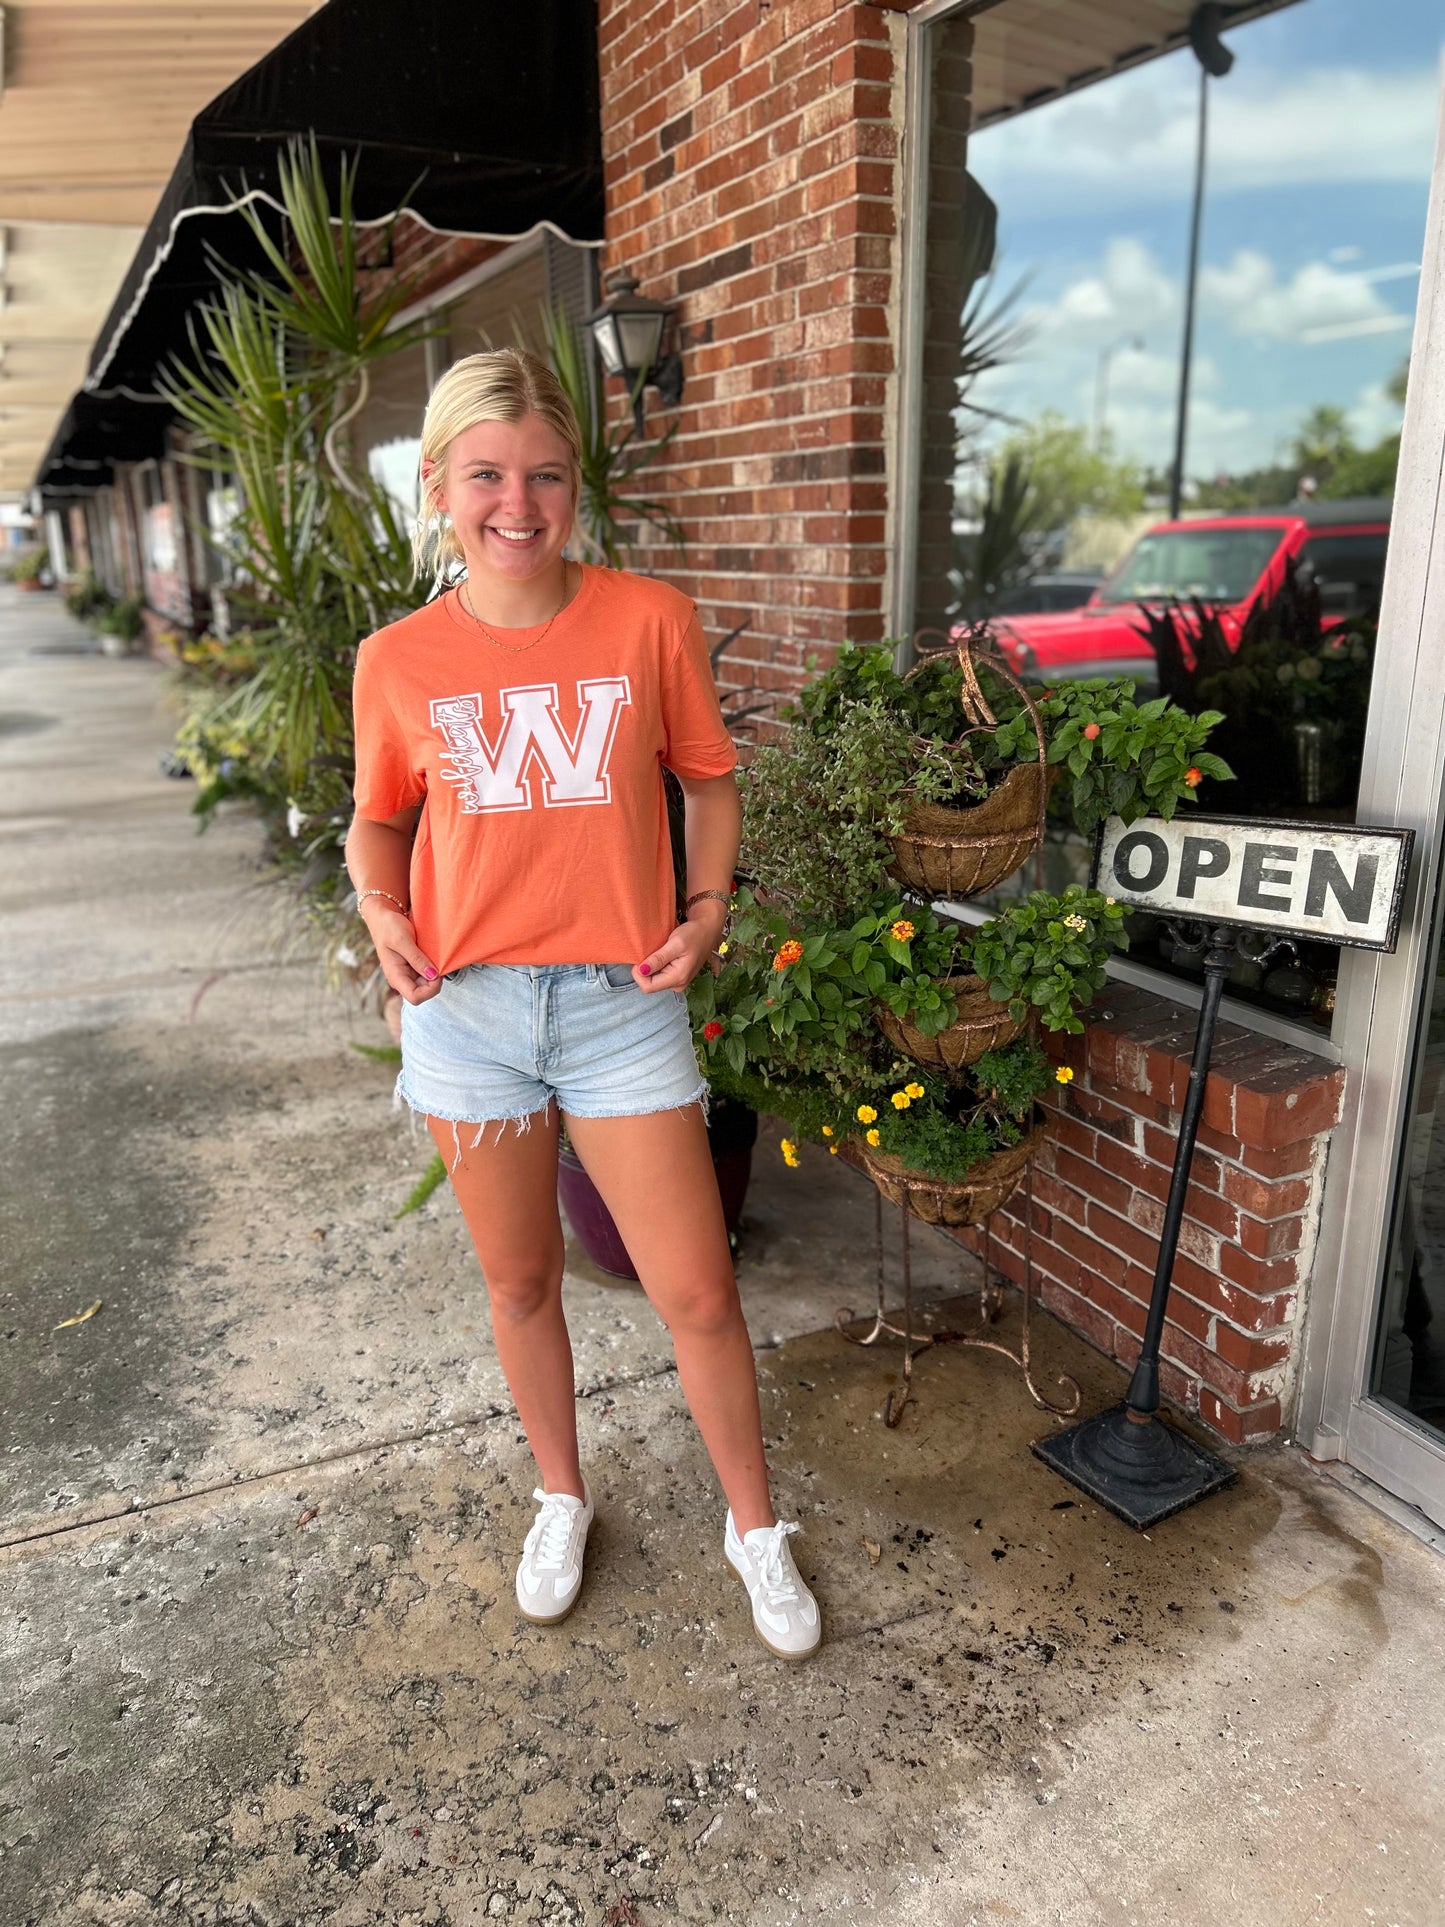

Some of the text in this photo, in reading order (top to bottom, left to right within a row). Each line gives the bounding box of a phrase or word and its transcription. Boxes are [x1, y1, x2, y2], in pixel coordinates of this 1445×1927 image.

[429, 675, 632, 814] W
[437, 697, 483, 814] wildcats
[1113, 831, 1379, 924] OPEN
